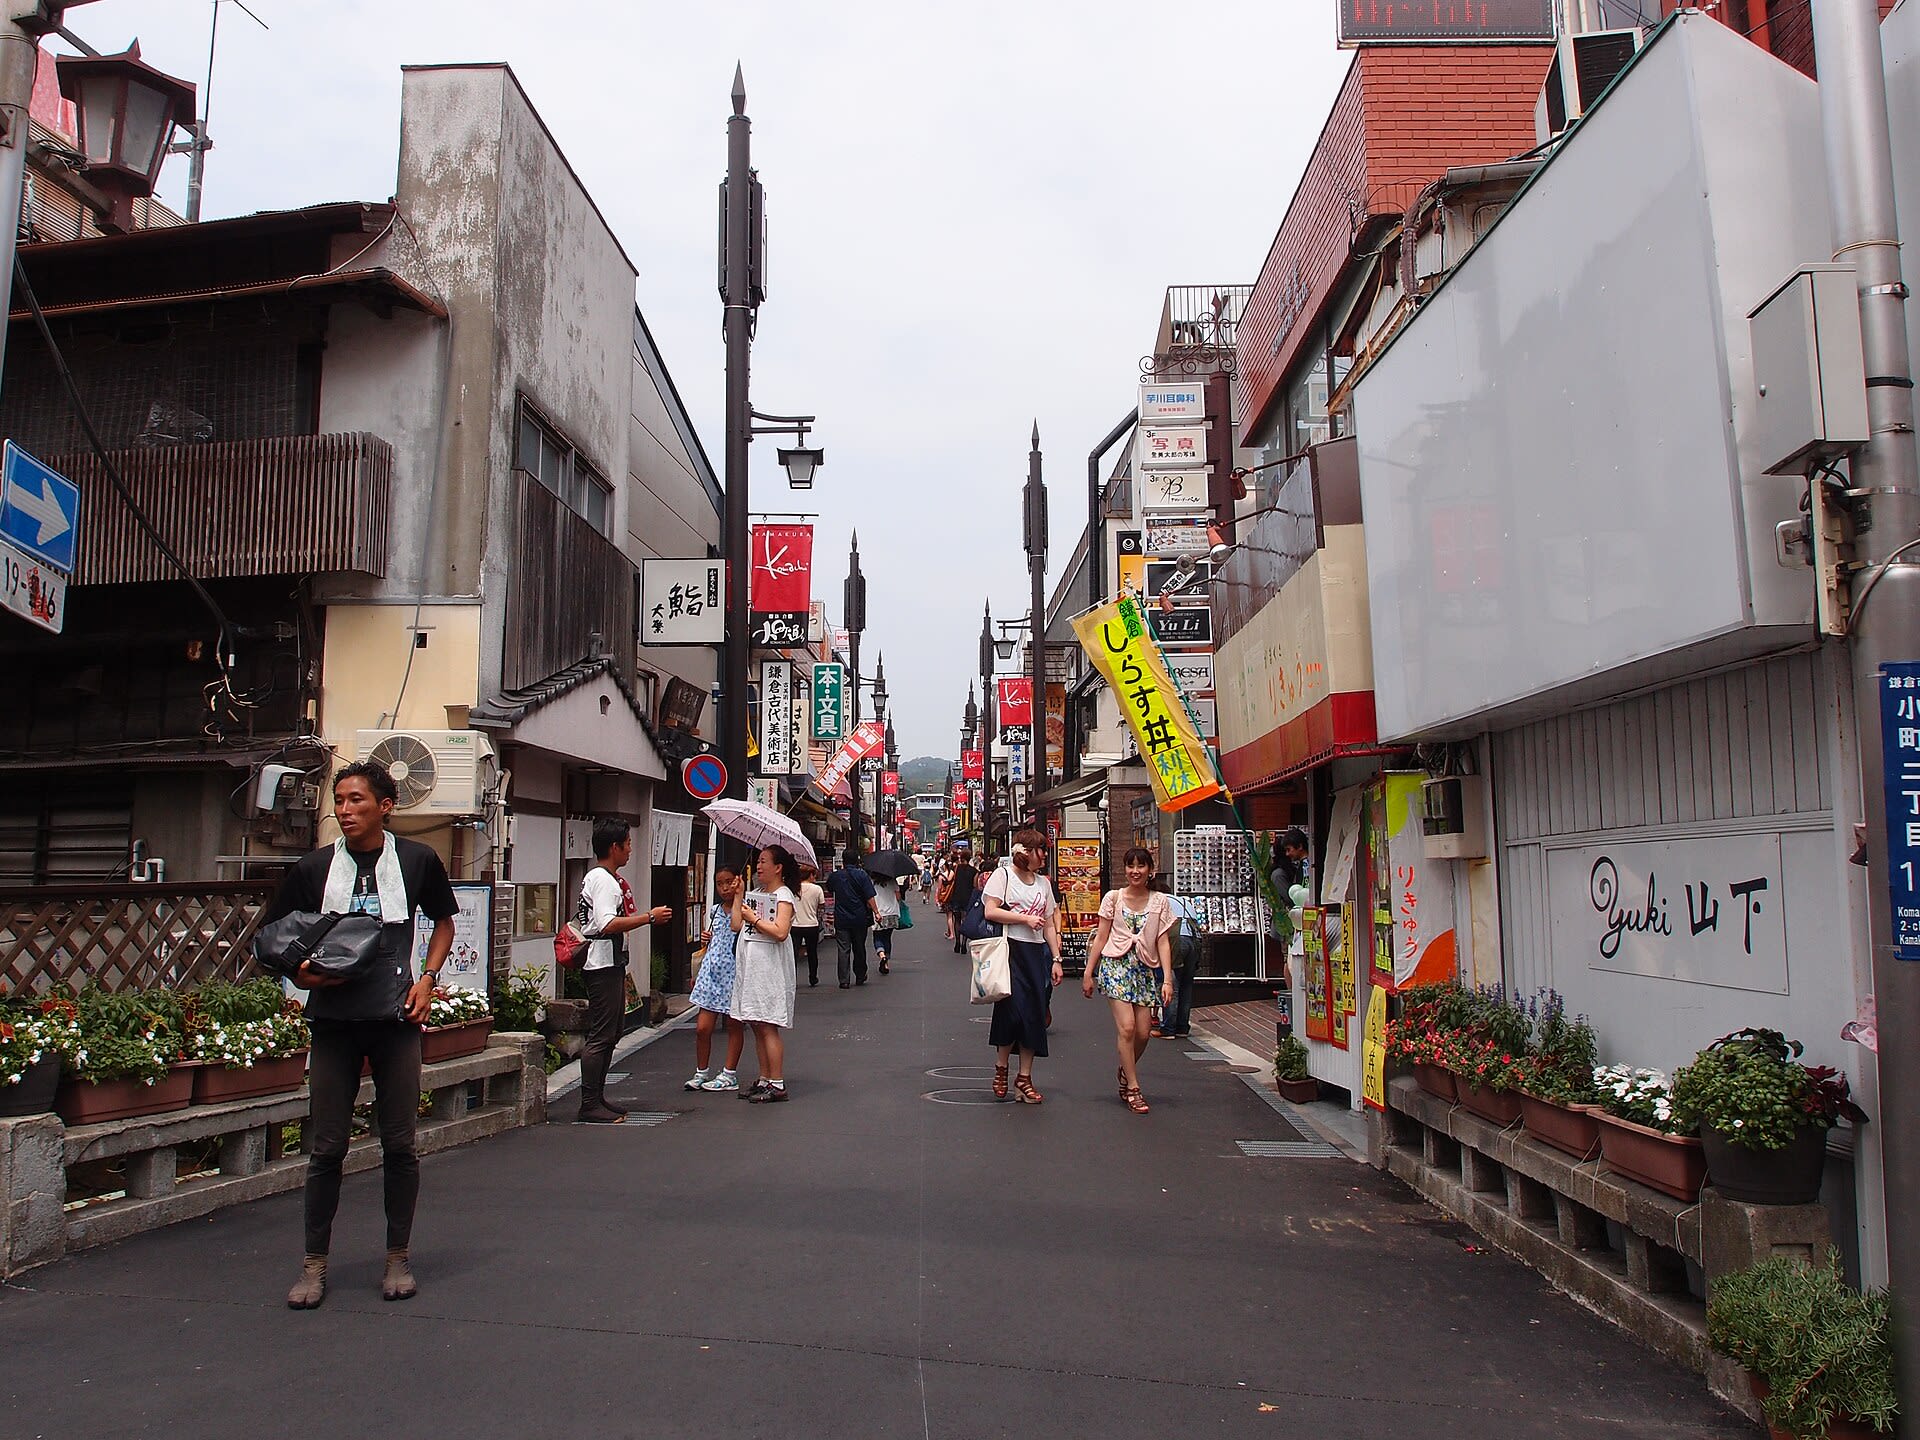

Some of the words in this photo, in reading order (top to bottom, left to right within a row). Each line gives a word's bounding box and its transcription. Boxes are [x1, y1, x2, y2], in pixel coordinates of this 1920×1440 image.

[1151, 438, 1194, 451] 写真
[668, 581, 704, 620] 鮨
[1119, 598, 1140, 638] 鎌倉
[1159, 619, 1178, 631] Yu
[1183, 618, 1200, 631] Li
[817, 667, 838, 735] 本・文具
[1103, 622, 1176, 755] しらす丼
[1888, 676, 1920, 688] 鎌倉
[767, 665, 783, 766] 鎌倉古代美術店
[1398, 865, 1419, 960] りきゅう
[1590, 855, 1673, 960] Yuki
[1684, 875, 1768, 955] 山下
